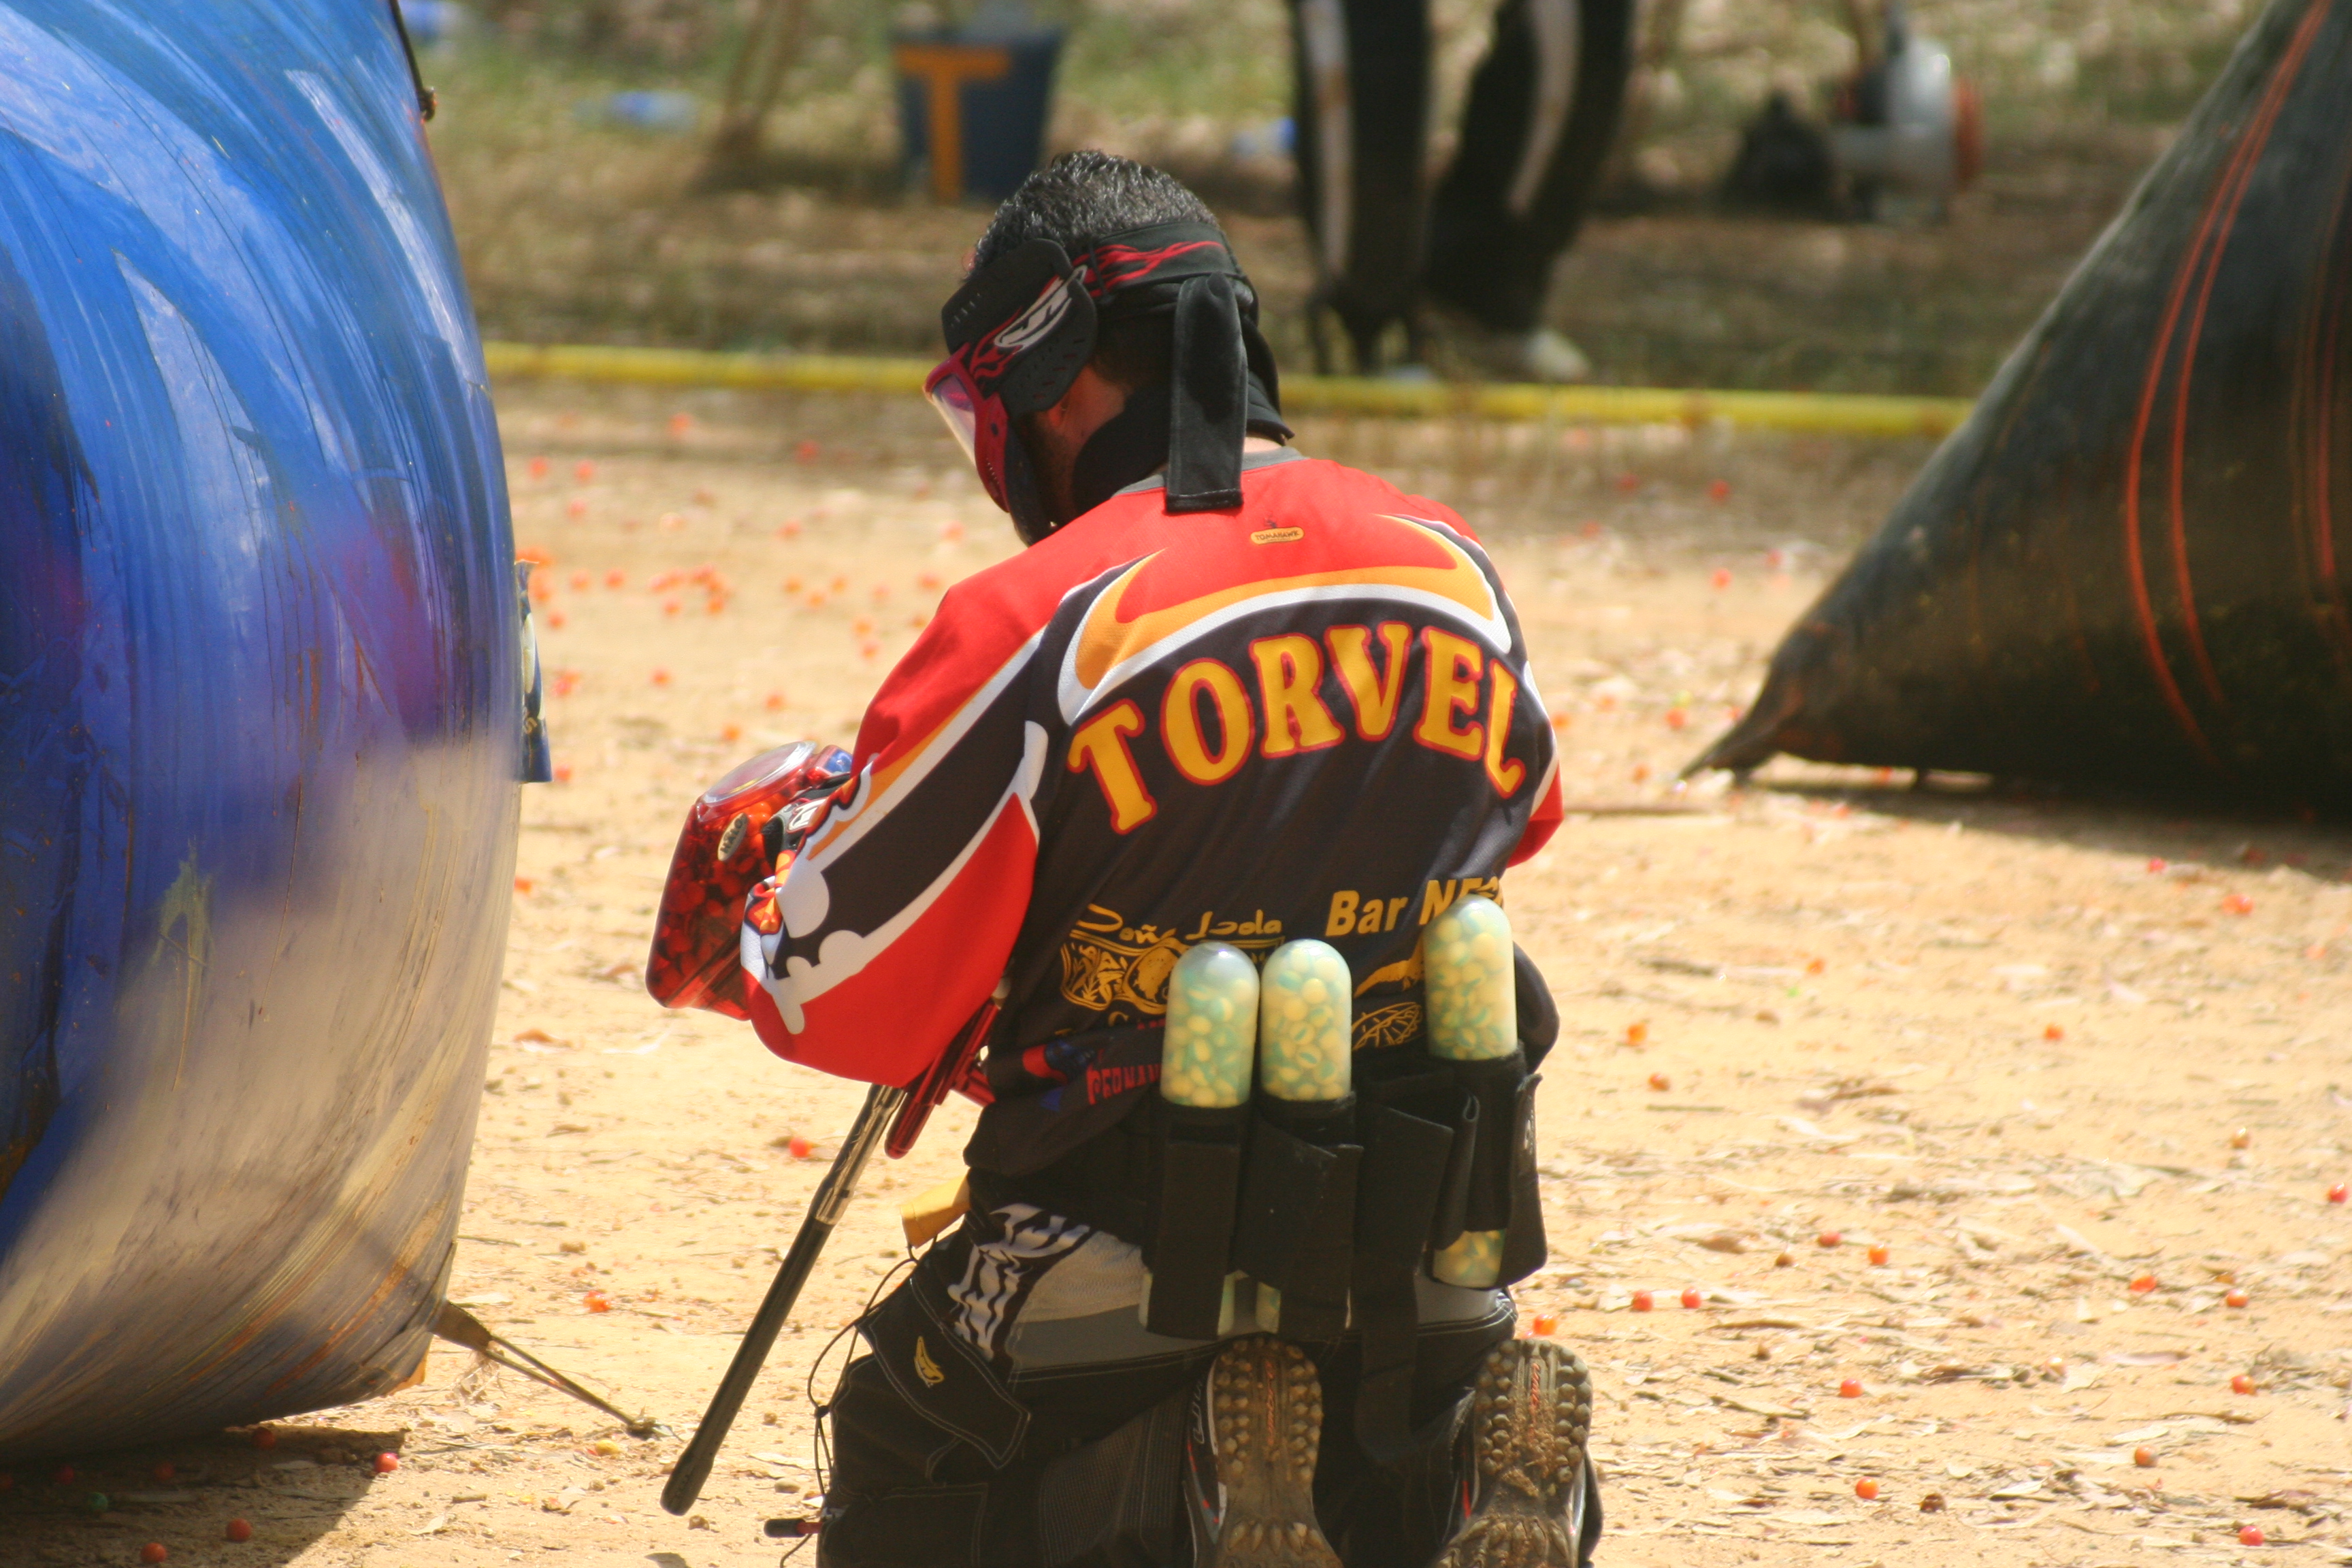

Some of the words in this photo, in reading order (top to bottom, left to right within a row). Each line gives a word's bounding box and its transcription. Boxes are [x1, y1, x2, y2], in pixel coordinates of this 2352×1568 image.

[894, 44, 1010, 201] T
[1067, 621, 1525, 835] TORVEL
[1324, 889, 1409, 937] Bar
